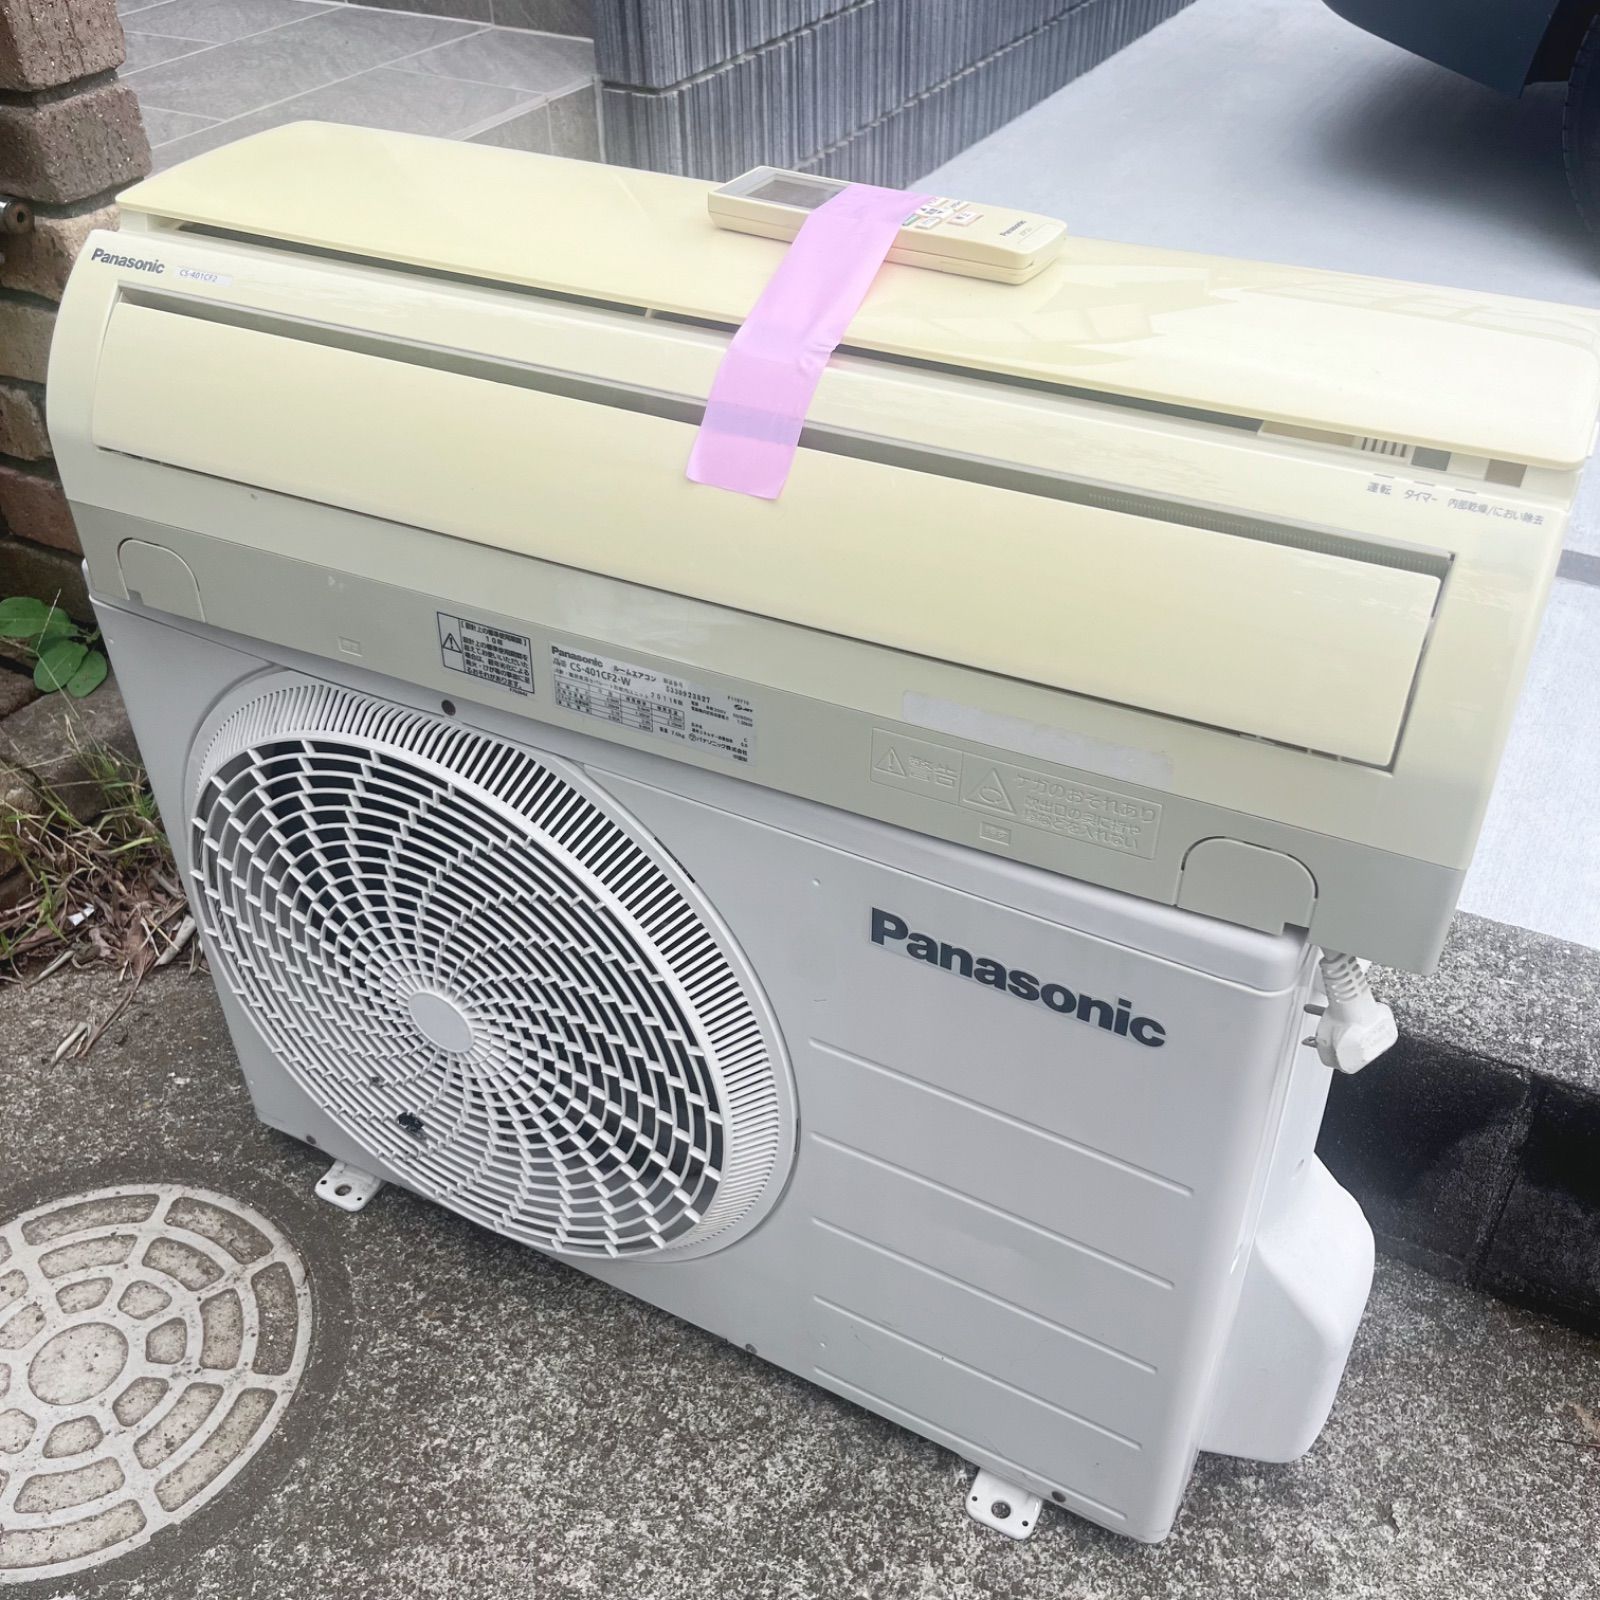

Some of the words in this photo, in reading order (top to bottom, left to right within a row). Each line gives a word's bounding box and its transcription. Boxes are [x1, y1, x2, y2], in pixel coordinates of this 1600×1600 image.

[91, 248, 165, 274] Panasonic
[179, 269, 218, 283] CS-401CF2
[1367, 481, 1392, 495] 運転
[1404, 489, 1438, 503] タイマー
[551, 645, 603, 668] Panasonic
[613, 665, 657, 682] ルームエアコン
[1014, 773, 1157, 823] ケガのおそれあり
[871, 906, 1167, 1048] Panasonic
